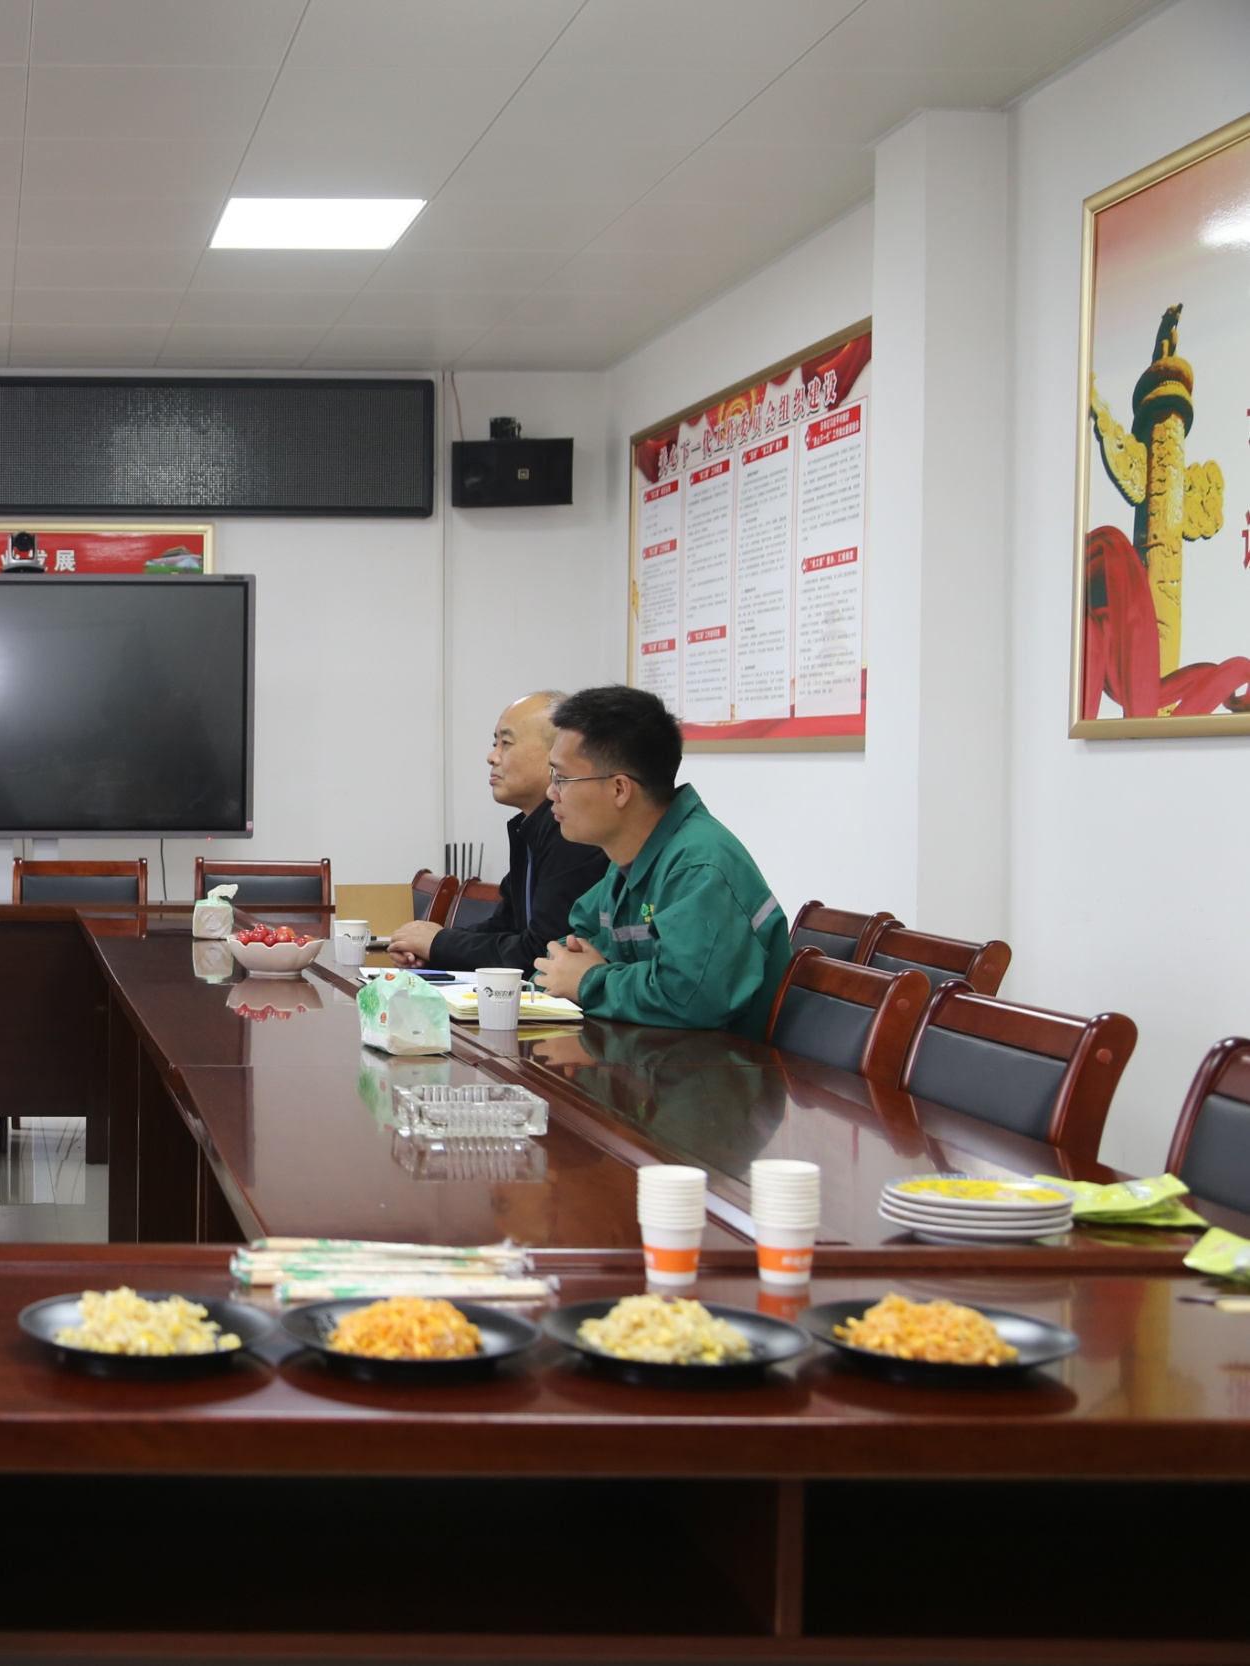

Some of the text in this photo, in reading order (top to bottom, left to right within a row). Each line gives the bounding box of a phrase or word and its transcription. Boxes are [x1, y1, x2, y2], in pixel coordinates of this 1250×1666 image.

[658, 370, 837, 476] 关心下一代工作委员会组织建设
